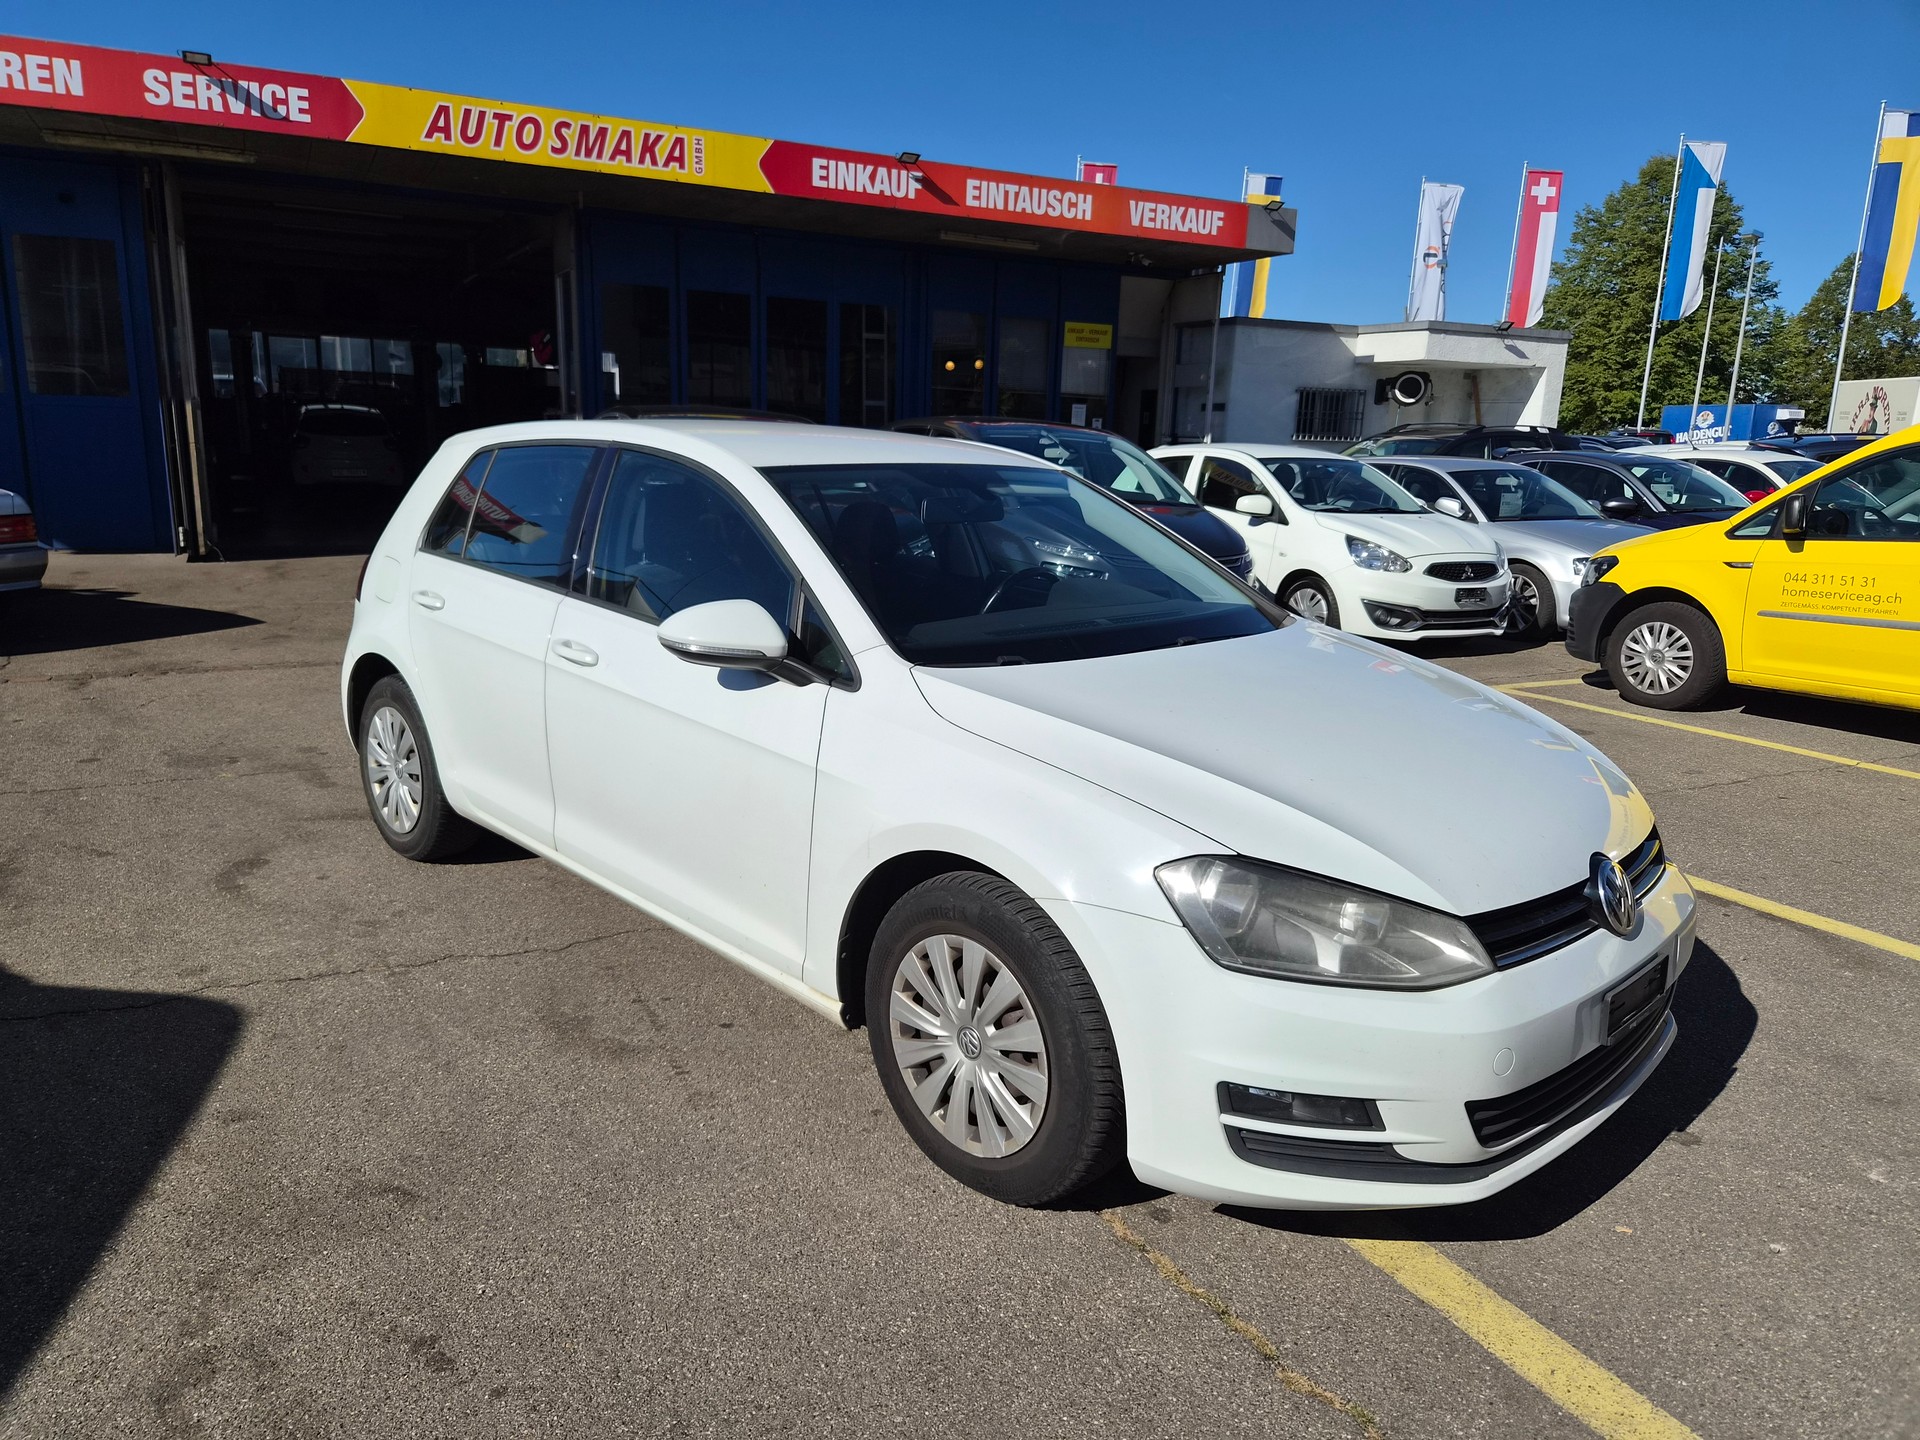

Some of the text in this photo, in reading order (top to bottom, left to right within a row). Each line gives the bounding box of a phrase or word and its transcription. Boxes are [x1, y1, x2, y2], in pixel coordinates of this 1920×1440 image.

[0, 51, 84, 97] REN
[142, 68, 312, 124] SERVICE
[424, 103, 687, 172] AUTO SMAKA
[694, 137, 703, 174] GMBH
[811, 157, 923, 199] EINKAUF
[966, 178, 1093, 221] EINTAUSCH
[1129, 200, 1225, 236] VERKAUF
[1675, 425, 1733, 443] HADENGUT
[1781, 585, 1902, 606] homeserviceag.ch
[1783, 572, 1877, 588] 044 311 51 31
